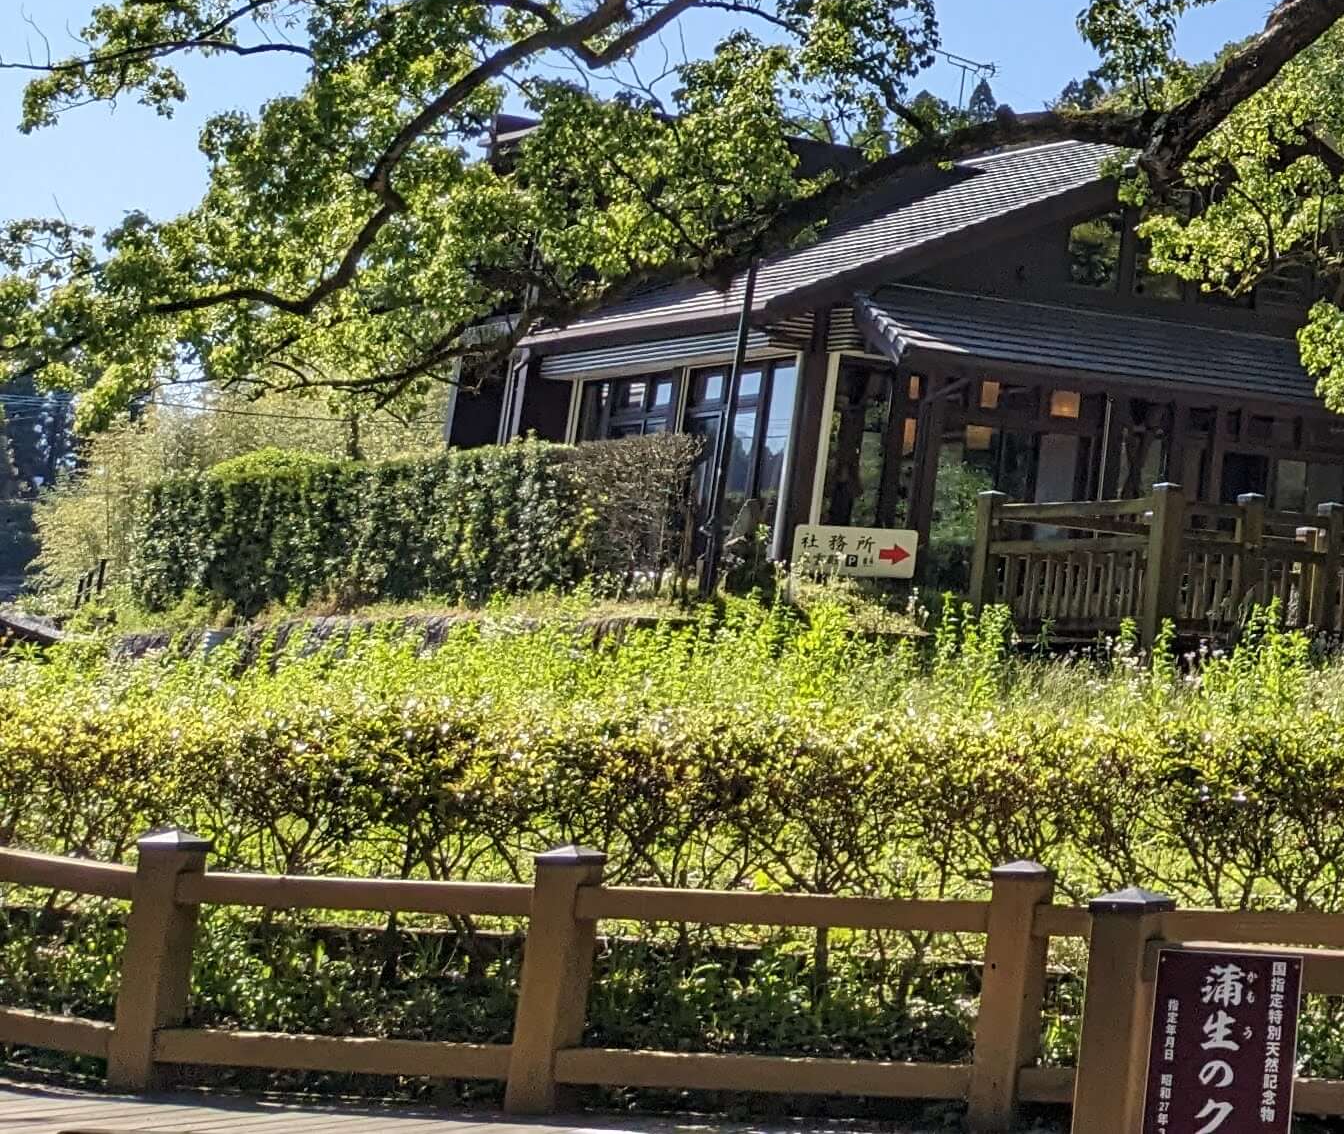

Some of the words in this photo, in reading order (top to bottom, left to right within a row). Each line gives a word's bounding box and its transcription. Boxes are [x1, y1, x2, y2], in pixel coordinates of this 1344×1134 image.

[801, 533, 876, 554] 社務所
[1164, 999, 1179, 1061] 指定年月日
[1194, 963, 1246, 1134] 蒲生のク
[1260, 962, 1287, 1122] 国指定特別天然記念物
